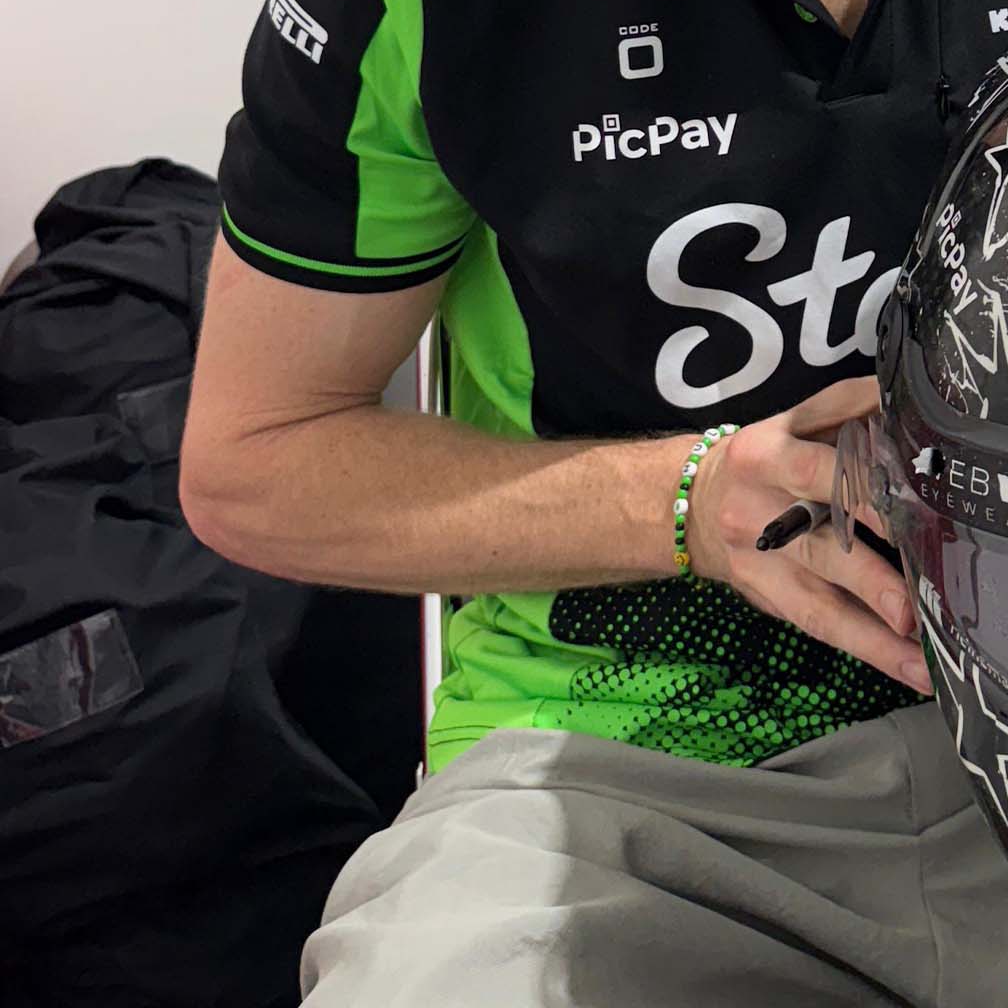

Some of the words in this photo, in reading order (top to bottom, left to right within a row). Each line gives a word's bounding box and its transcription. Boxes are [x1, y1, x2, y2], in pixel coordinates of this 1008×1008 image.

[619, 23, 659, 36] CODE
[572, 113, 738, 162] PicPay
[935, 203, 978, 316] PicPay
[646, 202, 905, 409] Sta
